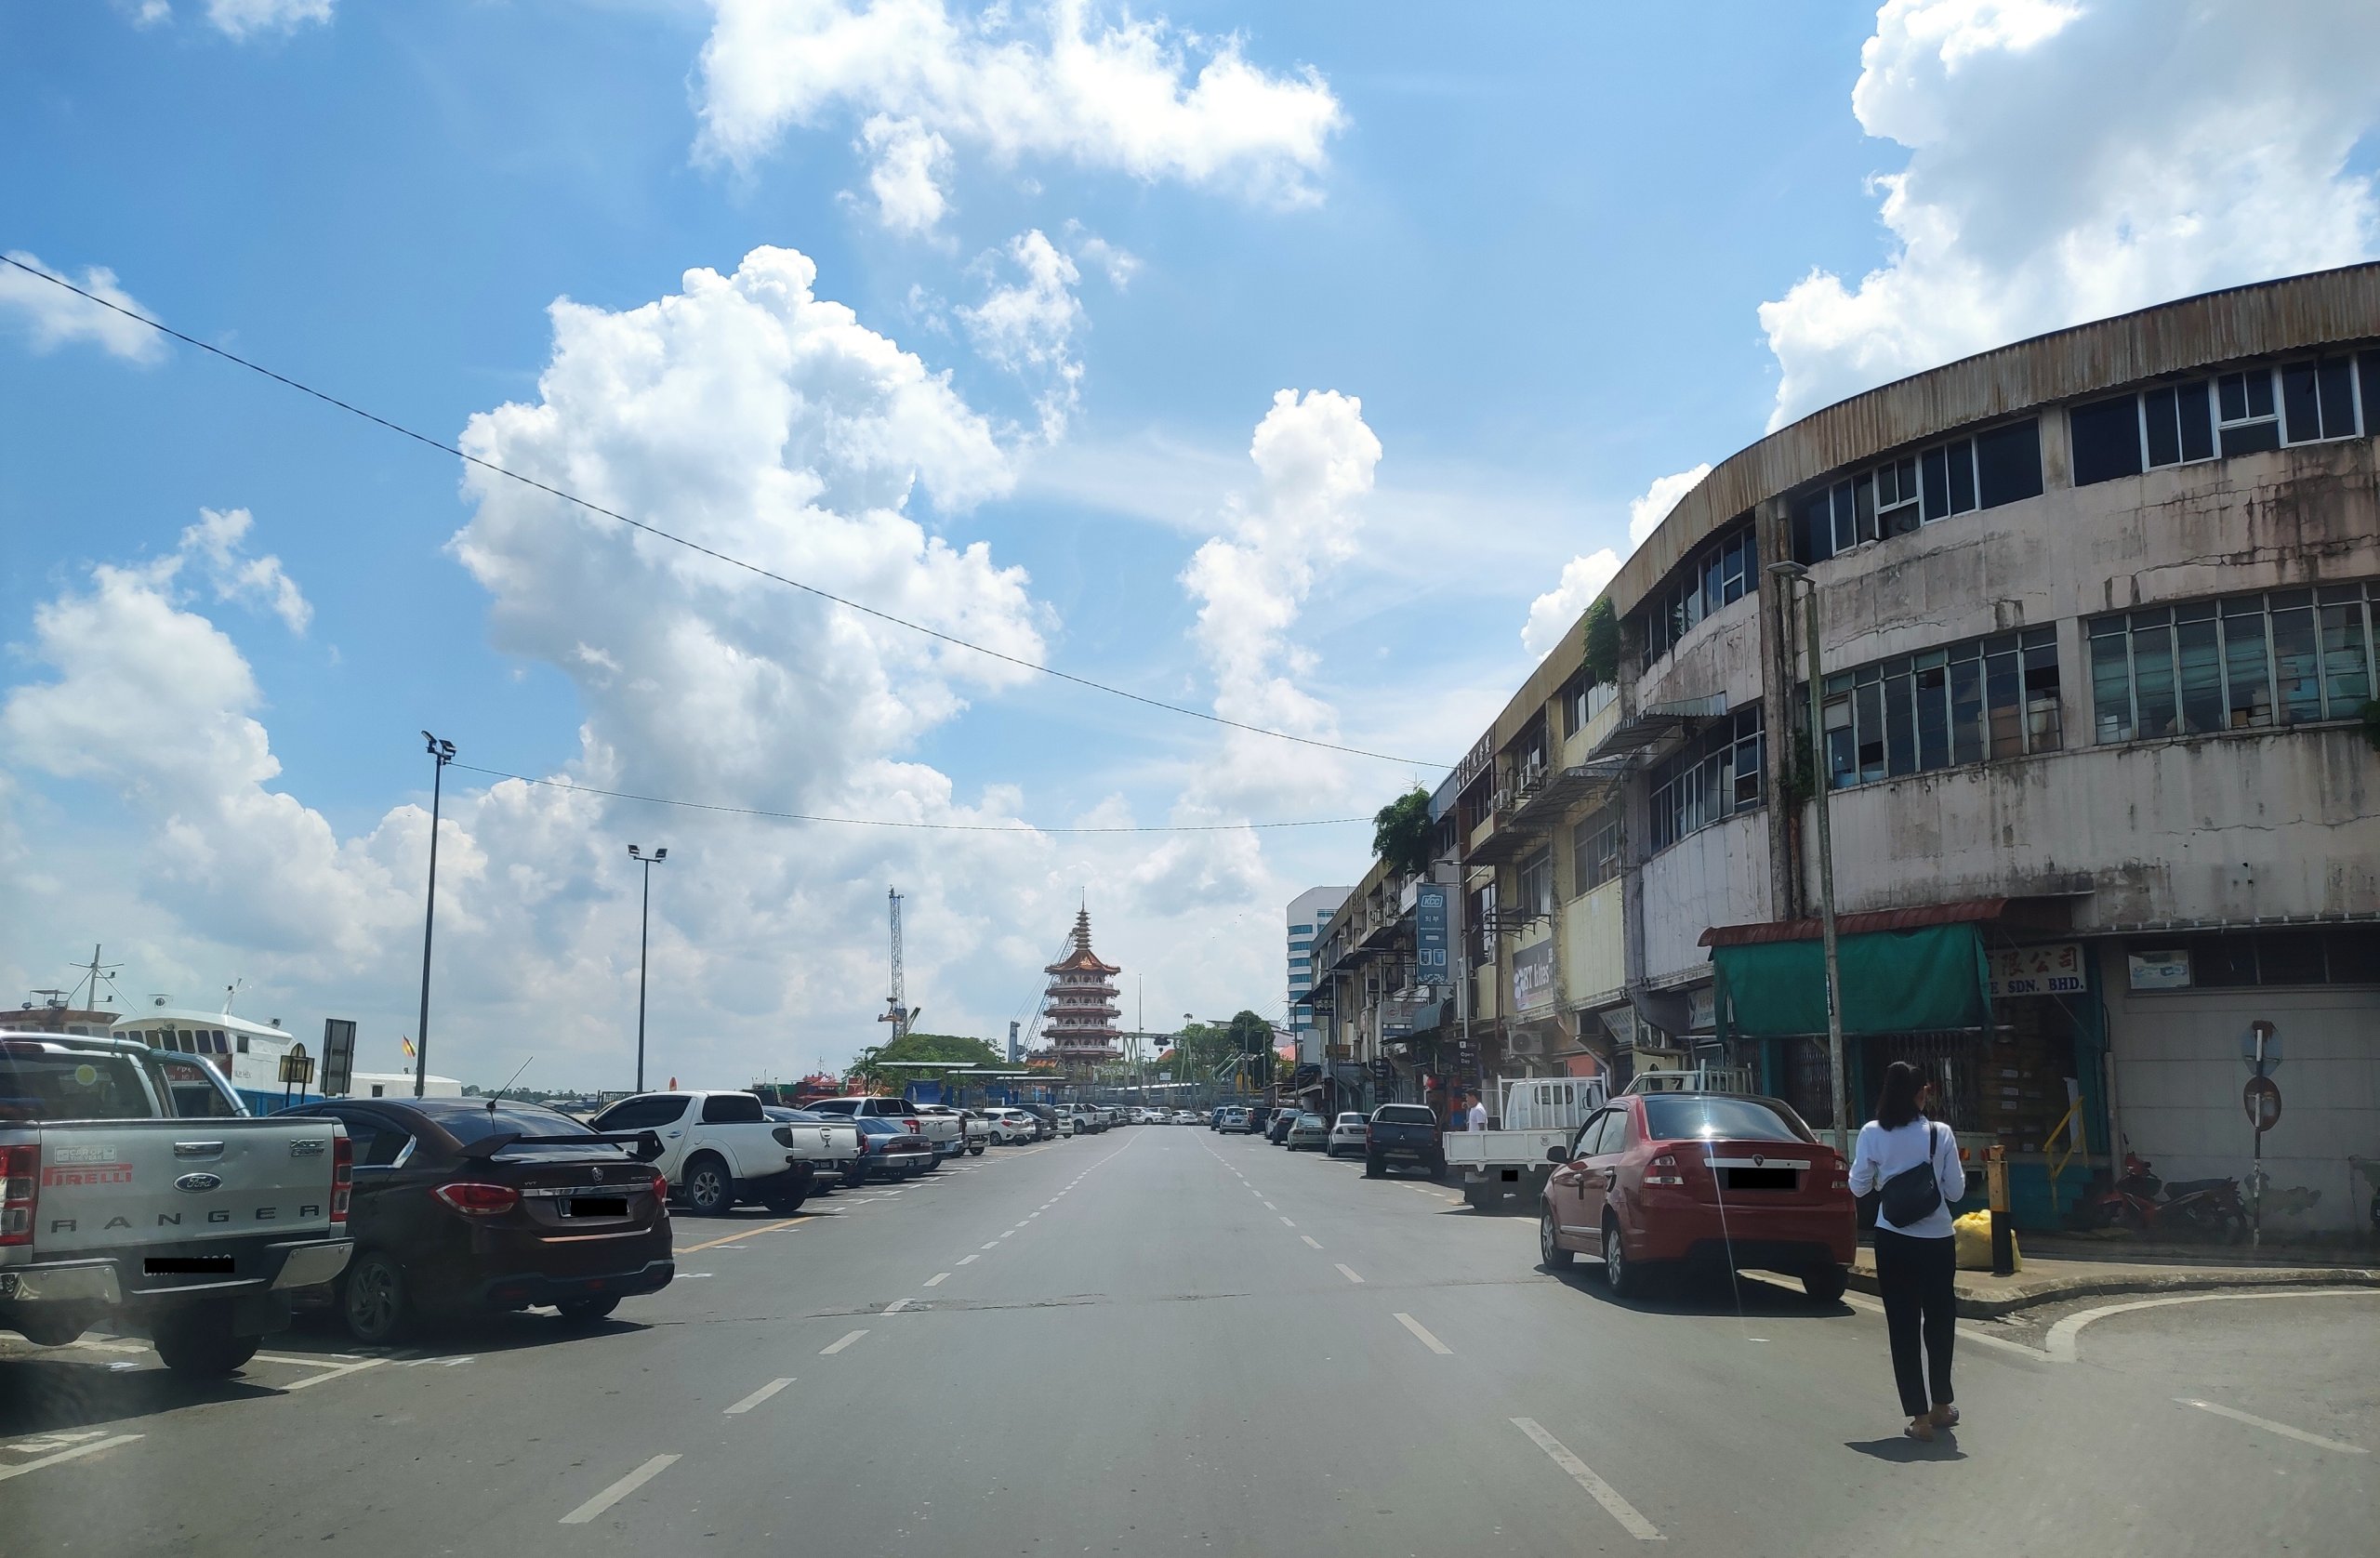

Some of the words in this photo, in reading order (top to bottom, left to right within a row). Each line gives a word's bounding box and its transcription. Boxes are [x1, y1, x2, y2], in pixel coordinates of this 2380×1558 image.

[1989, 946, 2078, 978] 限公司
[2008, 980, 2040, 993] SDN.
[2048, 977, 2083, 991] BHD.
[43, 1164, 133, 1187] PIRELLI
[186, 1176, 212, 1188] Ford
[51, 1205, 320, 1234] RANGER
